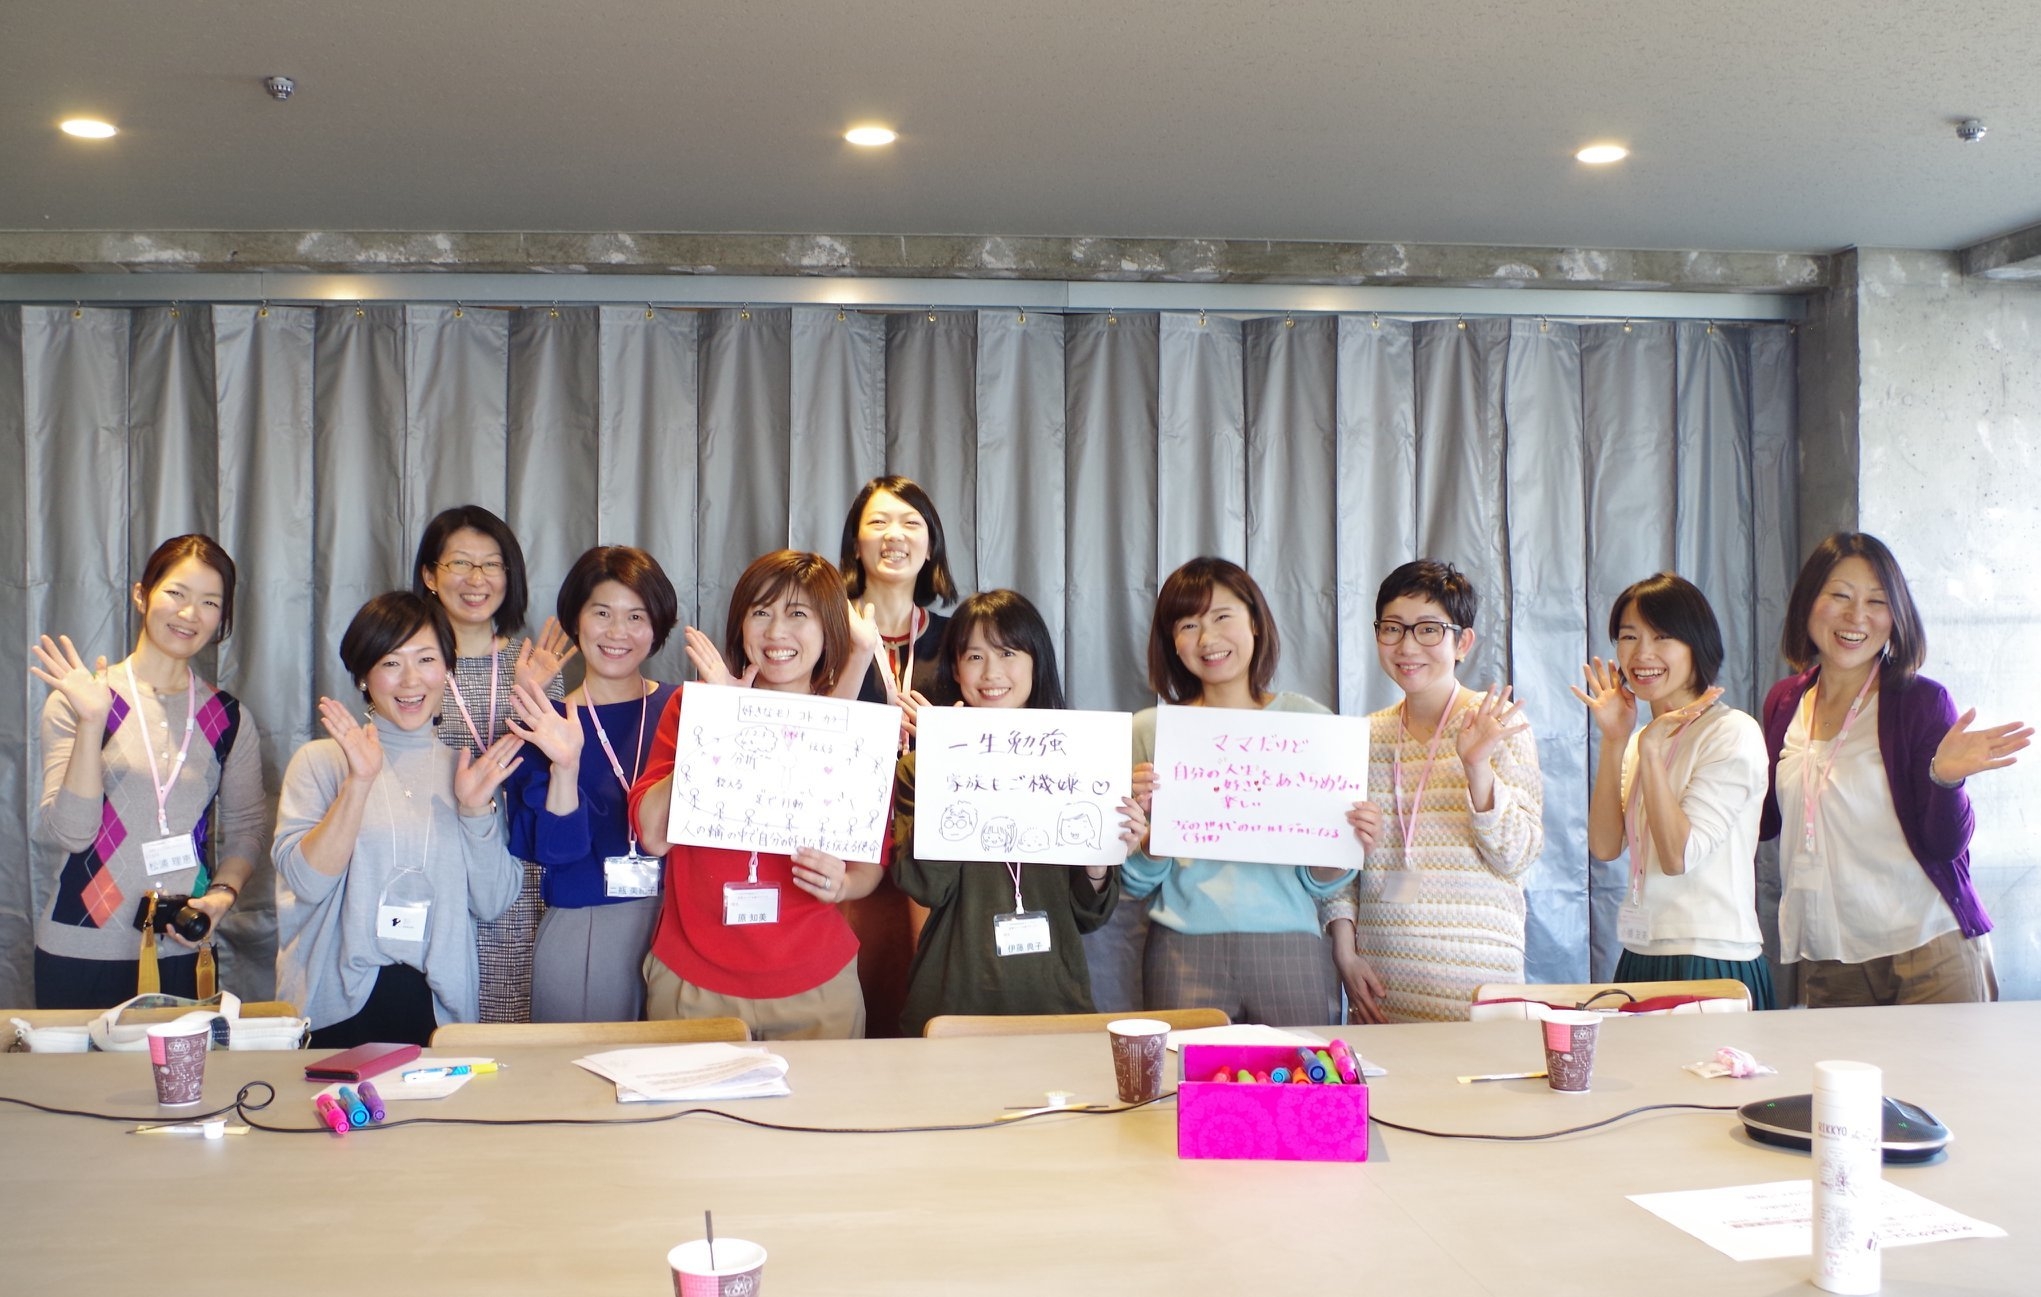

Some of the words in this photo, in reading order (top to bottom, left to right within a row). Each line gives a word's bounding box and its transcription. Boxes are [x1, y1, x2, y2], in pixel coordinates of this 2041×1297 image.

[948, 728, 1068, 756] 一生勉強
[1212, 734, 1309, 754] ママだけど
